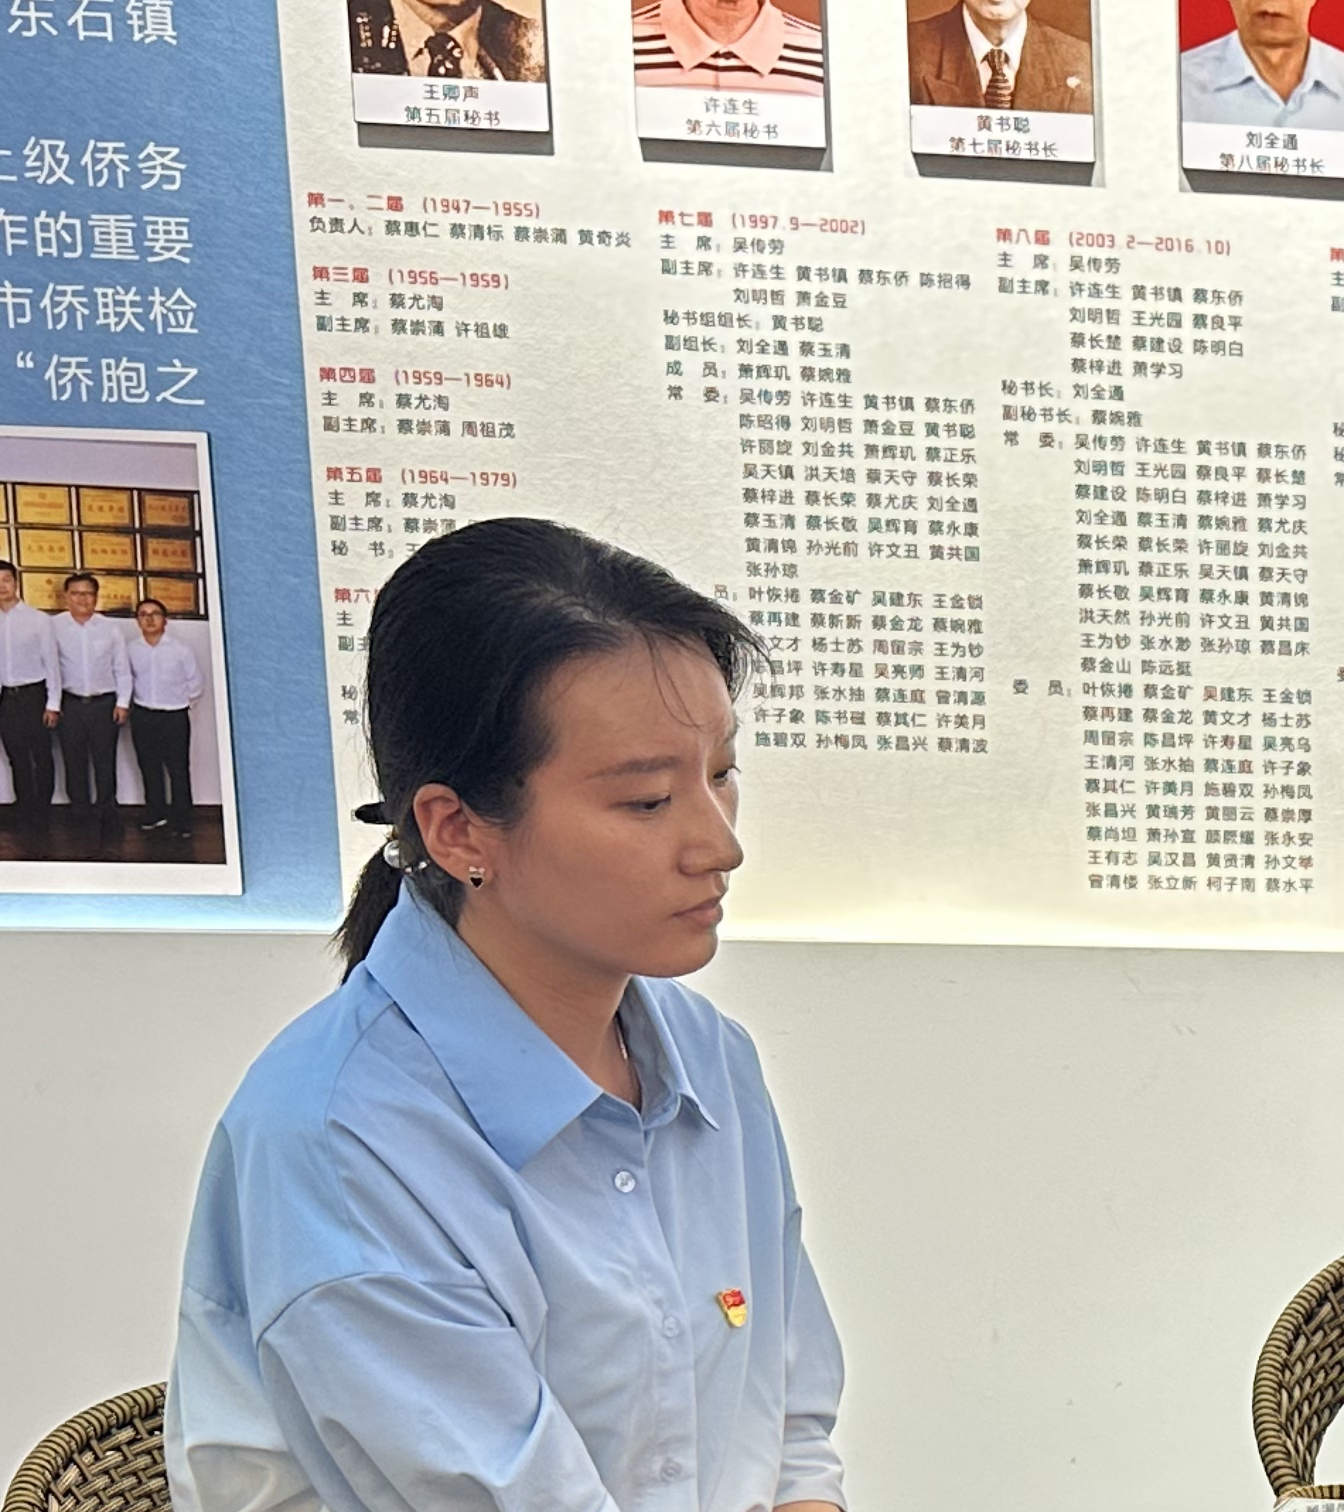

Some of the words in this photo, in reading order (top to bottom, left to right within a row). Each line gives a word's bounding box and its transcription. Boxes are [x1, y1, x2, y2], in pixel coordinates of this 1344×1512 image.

[403, 104, 501, 127] 第五届秘书
[703, 95, 760, 117] 许连生
[685, 117, 779, 140] 第六届秘书
[975, 113, 1031, 134] 黄书聪
[948, 135, 1059, 159] 第七届秘书长
[1245, 131, 1298, 150] 刘全通
[1219, 152, 1325, 174] 第八届秘书长
